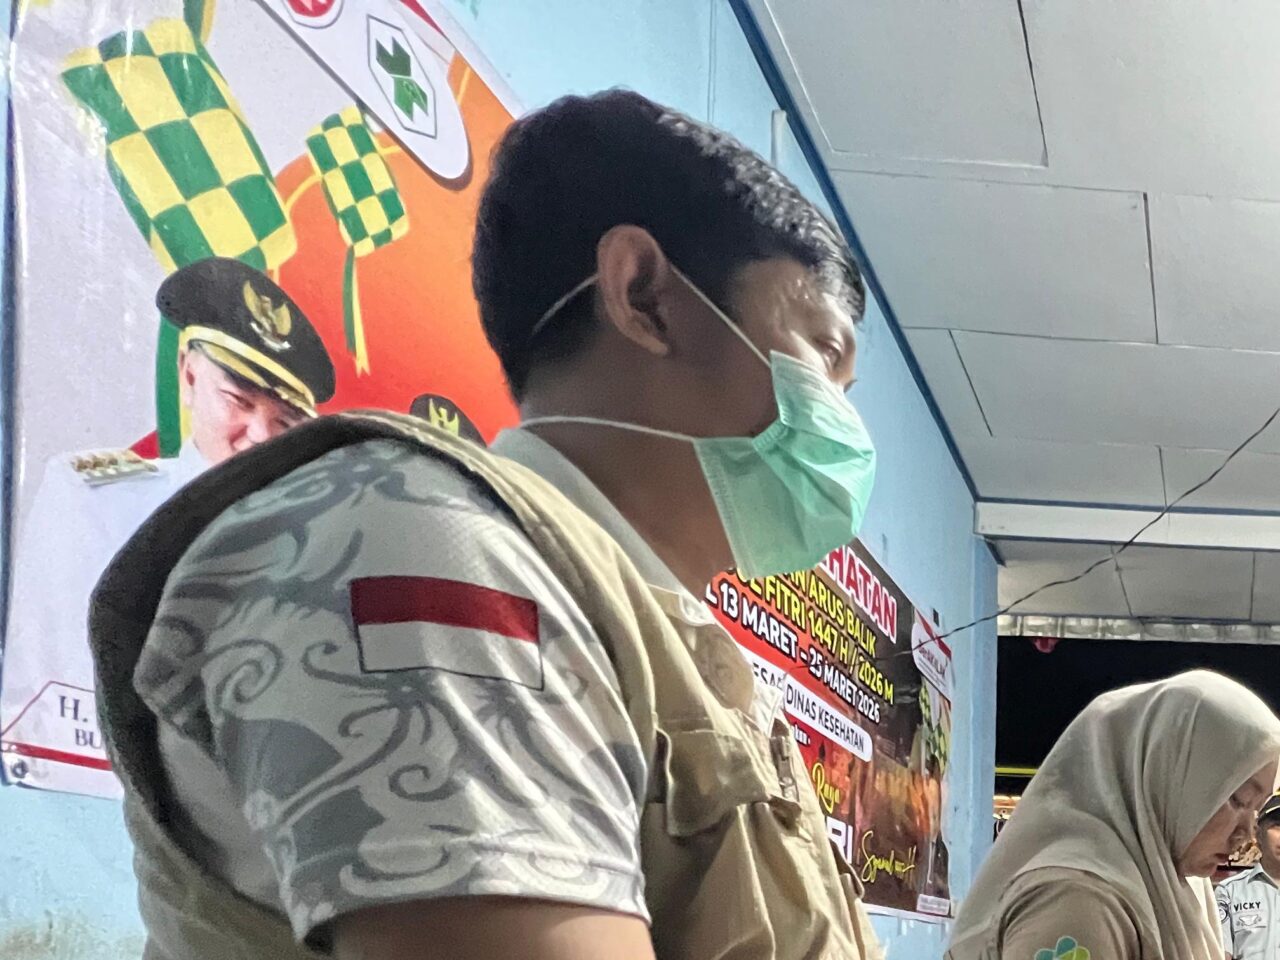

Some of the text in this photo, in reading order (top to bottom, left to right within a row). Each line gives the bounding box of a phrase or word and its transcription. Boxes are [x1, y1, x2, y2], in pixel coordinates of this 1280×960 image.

[808, 572, 845, 627] ARUS
[847, 608, 877, 657] BALIK
[820, 545, 897, 645] HATAN
[720, 582, 739, 619] 13
[742, 597, 798, 659] MARET
[809, 648, 823, 678] 25
[824, 661, 857, 706] MARET
[858, 691, 880, 723] 2026
[766, 575, 806, 629] FITRI
[809, 611, 838, 654] 1447
[840, 637, 849, 665] H
[858, 656, 883, 697] 2026
[885, 679, 894, 705] M
[59, 695, 88, 722] H.
[786, 684, 816, 720] DINAS
[818, 706, 865, 752] KESEHATAN
[1234, 901, 1261, 913] VICKY
